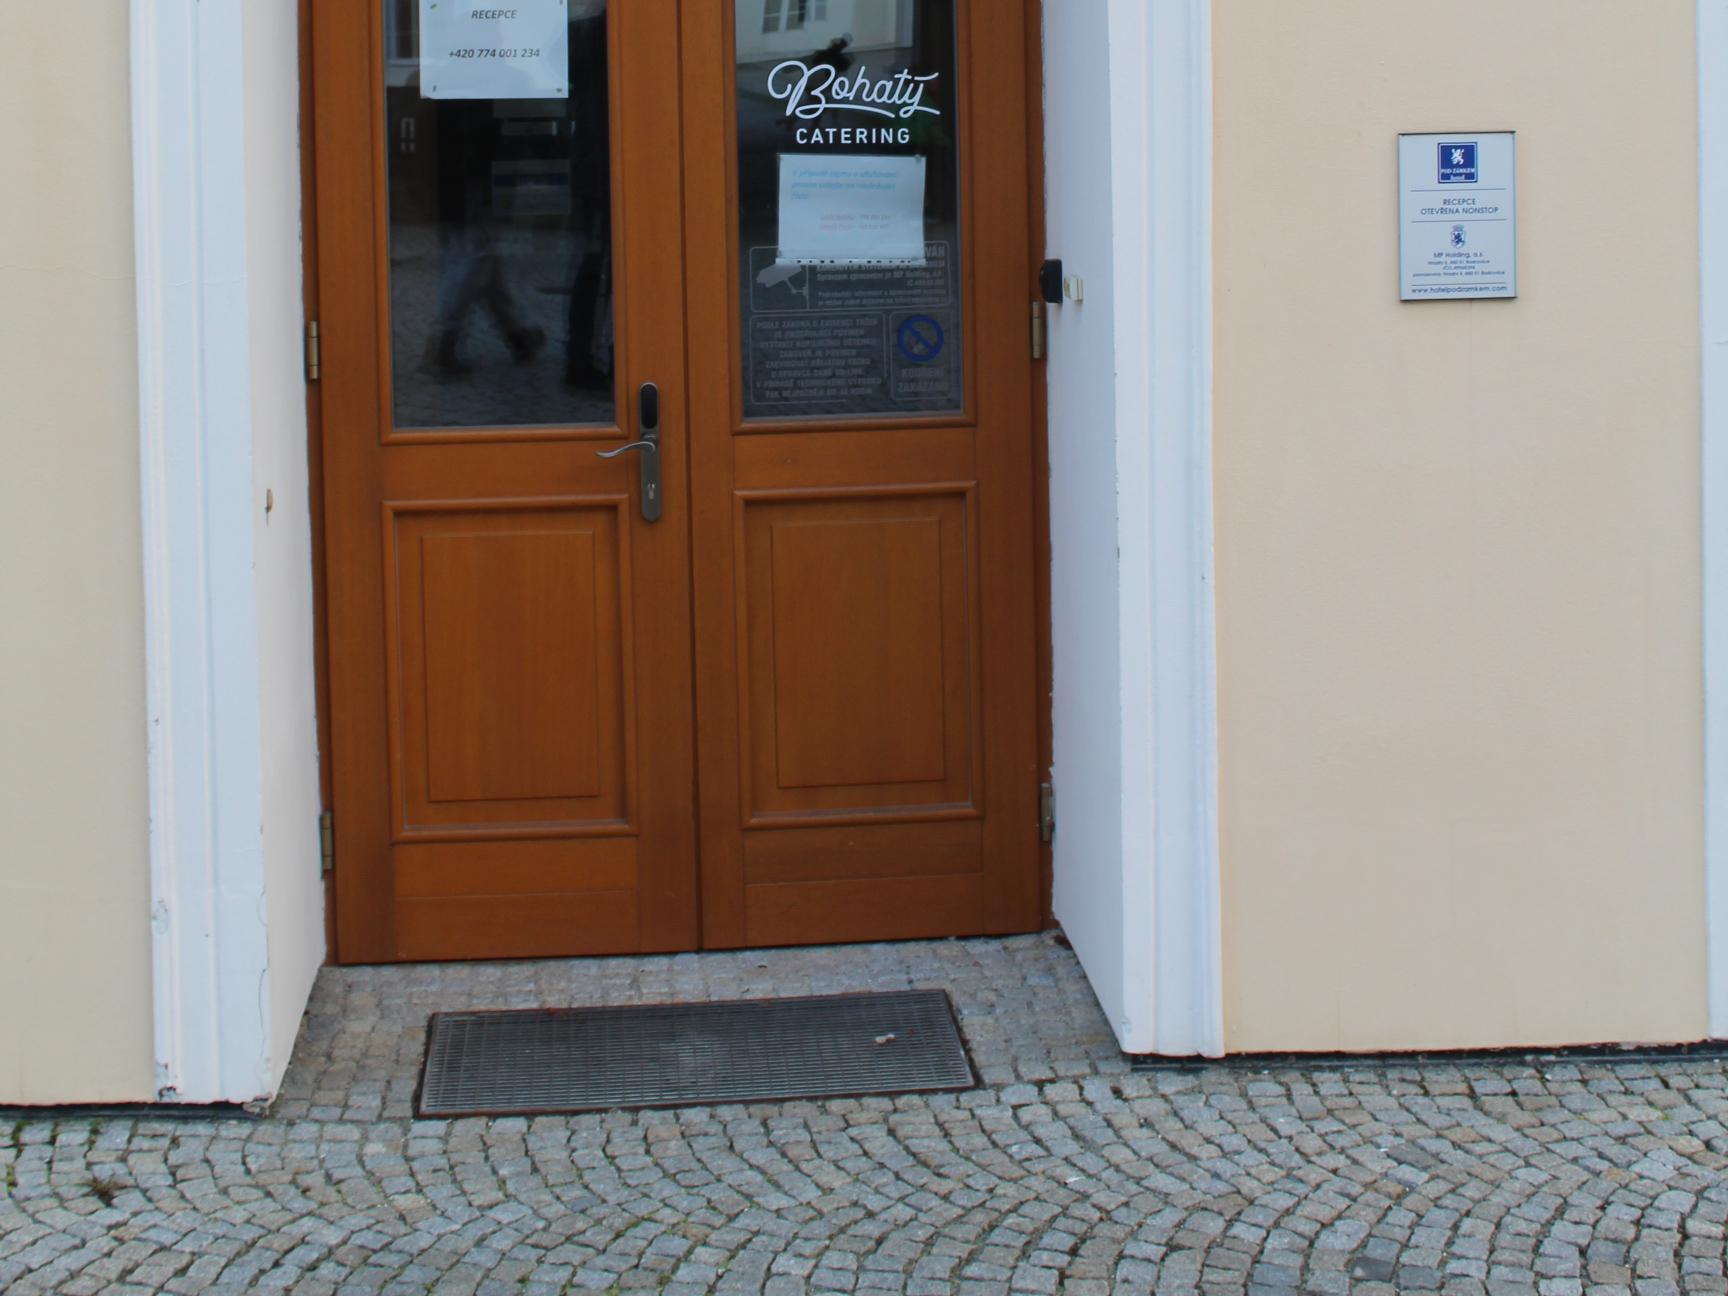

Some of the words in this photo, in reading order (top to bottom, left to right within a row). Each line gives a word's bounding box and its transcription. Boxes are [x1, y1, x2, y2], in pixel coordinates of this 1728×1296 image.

[471, 9, 518, 20] RECEPCE
[448, 49, 475, 58] +420
[477, 48, 496, 58] 774
[499, 48, 518, 58] 001
[521, 48, 541, 58] 234
[796, 128, 910, 144] CATERING
[1462, 206, 1499, 214] NONSTOP
